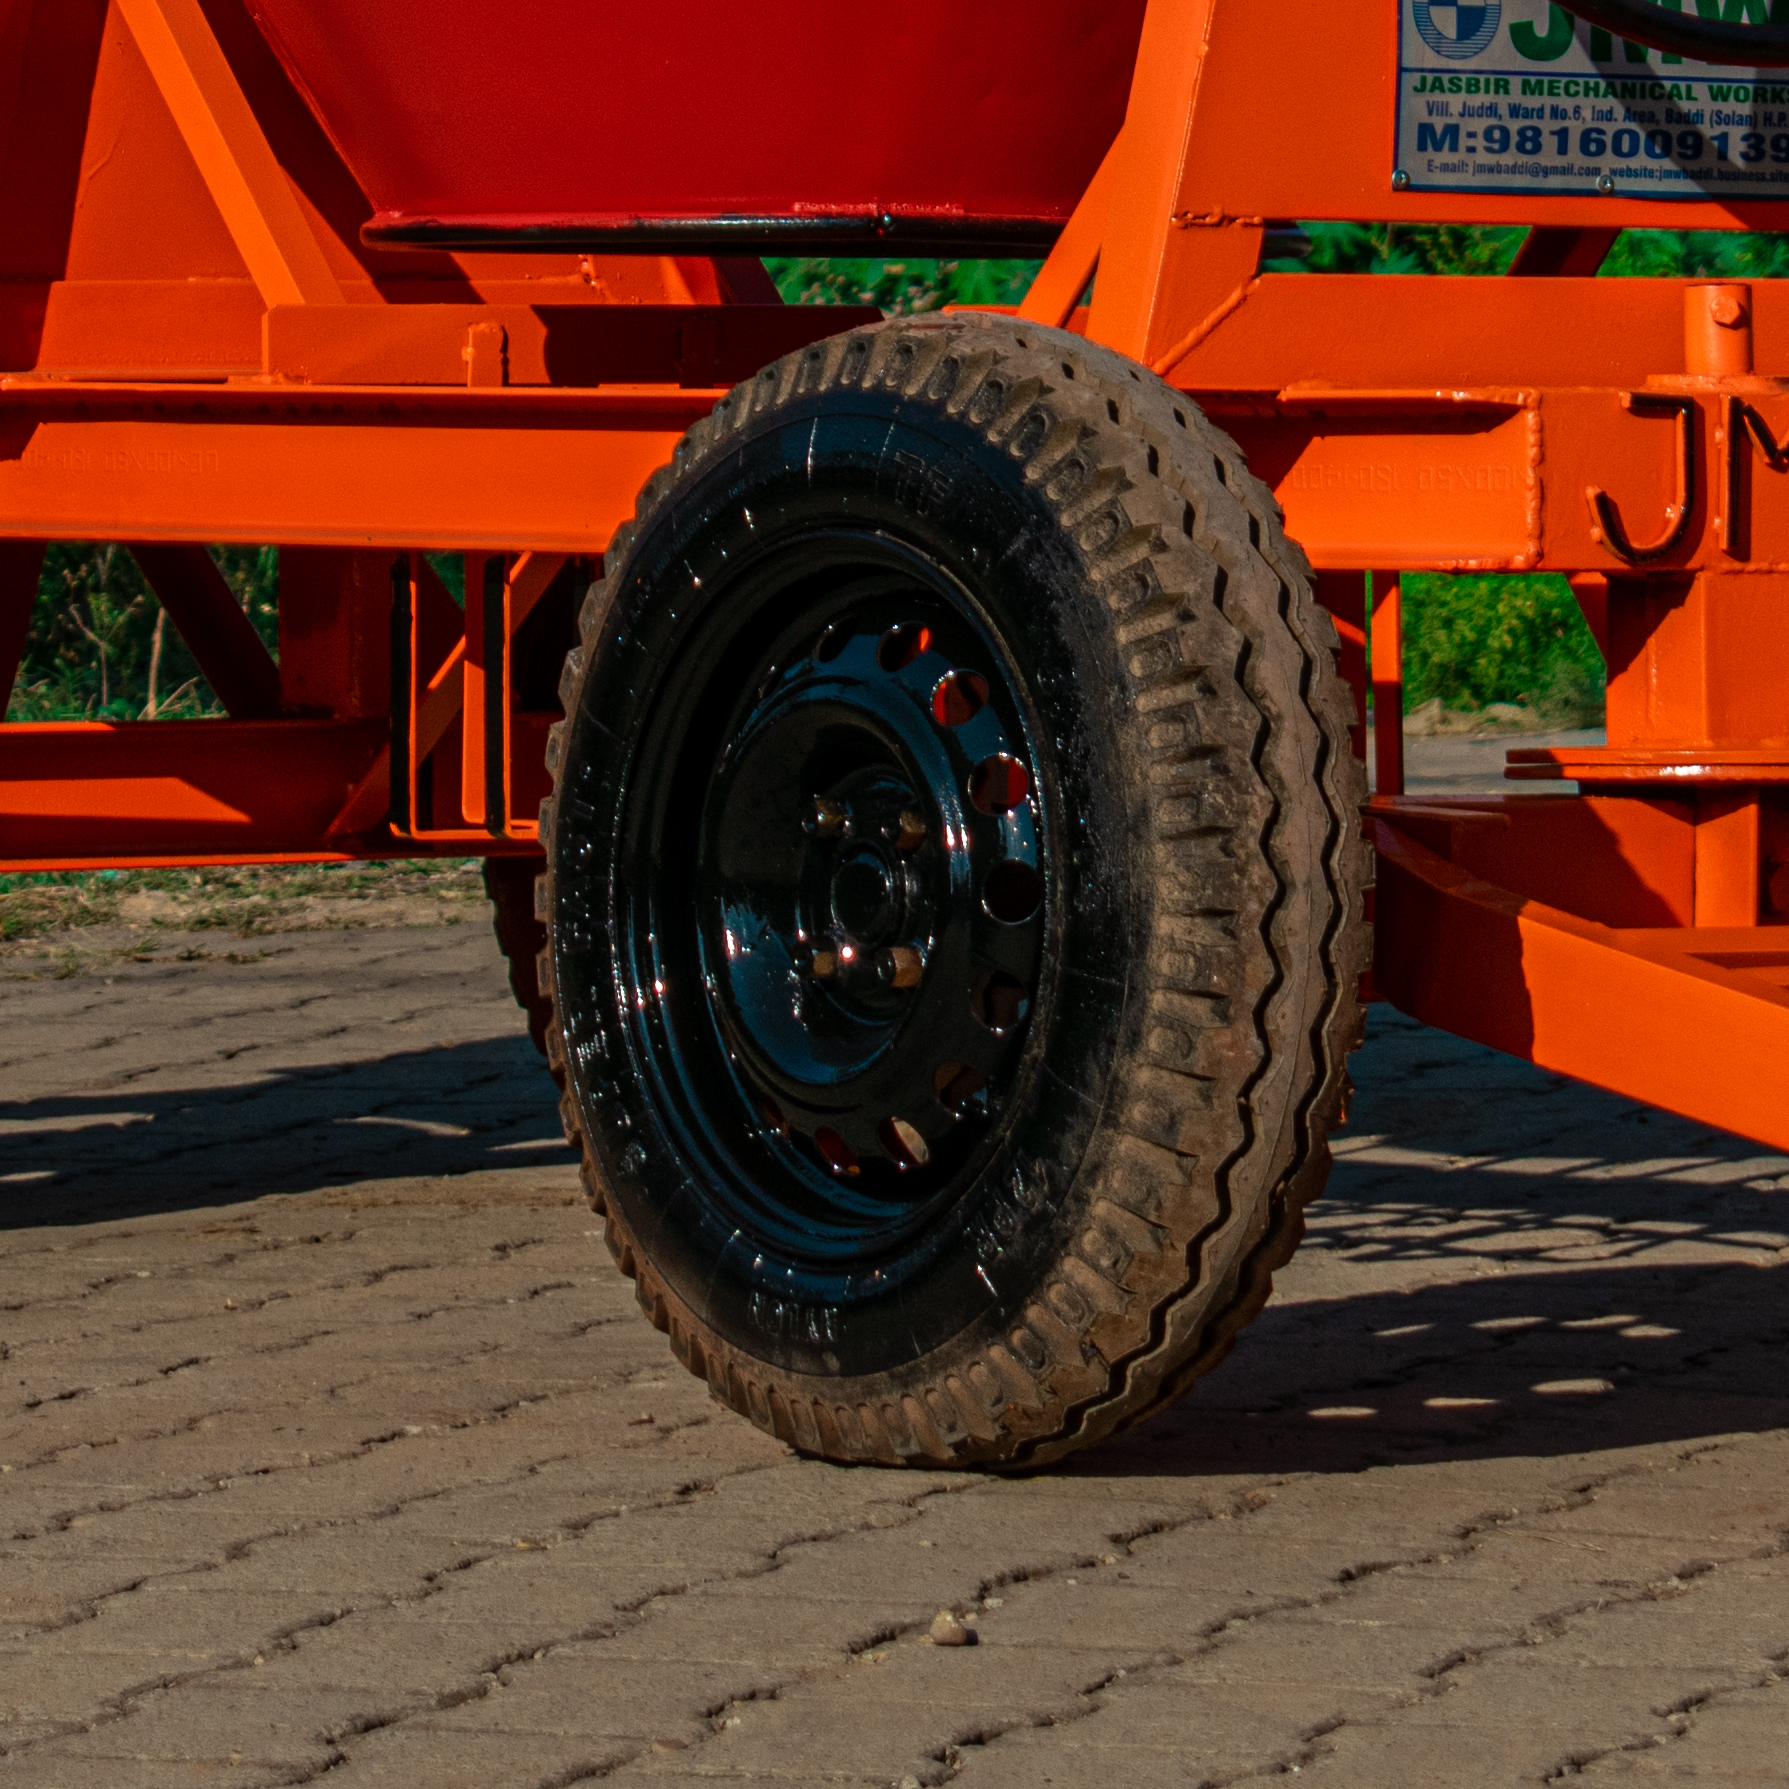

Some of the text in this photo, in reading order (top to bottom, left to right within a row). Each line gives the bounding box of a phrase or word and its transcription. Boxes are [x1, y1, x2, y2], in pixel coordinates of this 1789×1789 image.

[1413, 74, 1511, 96] JASBIR
[1521, 78, 1699, 102] MECHANICAL
[1426, 100, 1789, 129] Vill. Juddi, Ward No.6, Ind. Area, Baddi (Solan) H.P.
[1427, 159, 1469, 174] E-mail:
[1472, 160, 1602, 178] jmwbaddi@gmail.com
